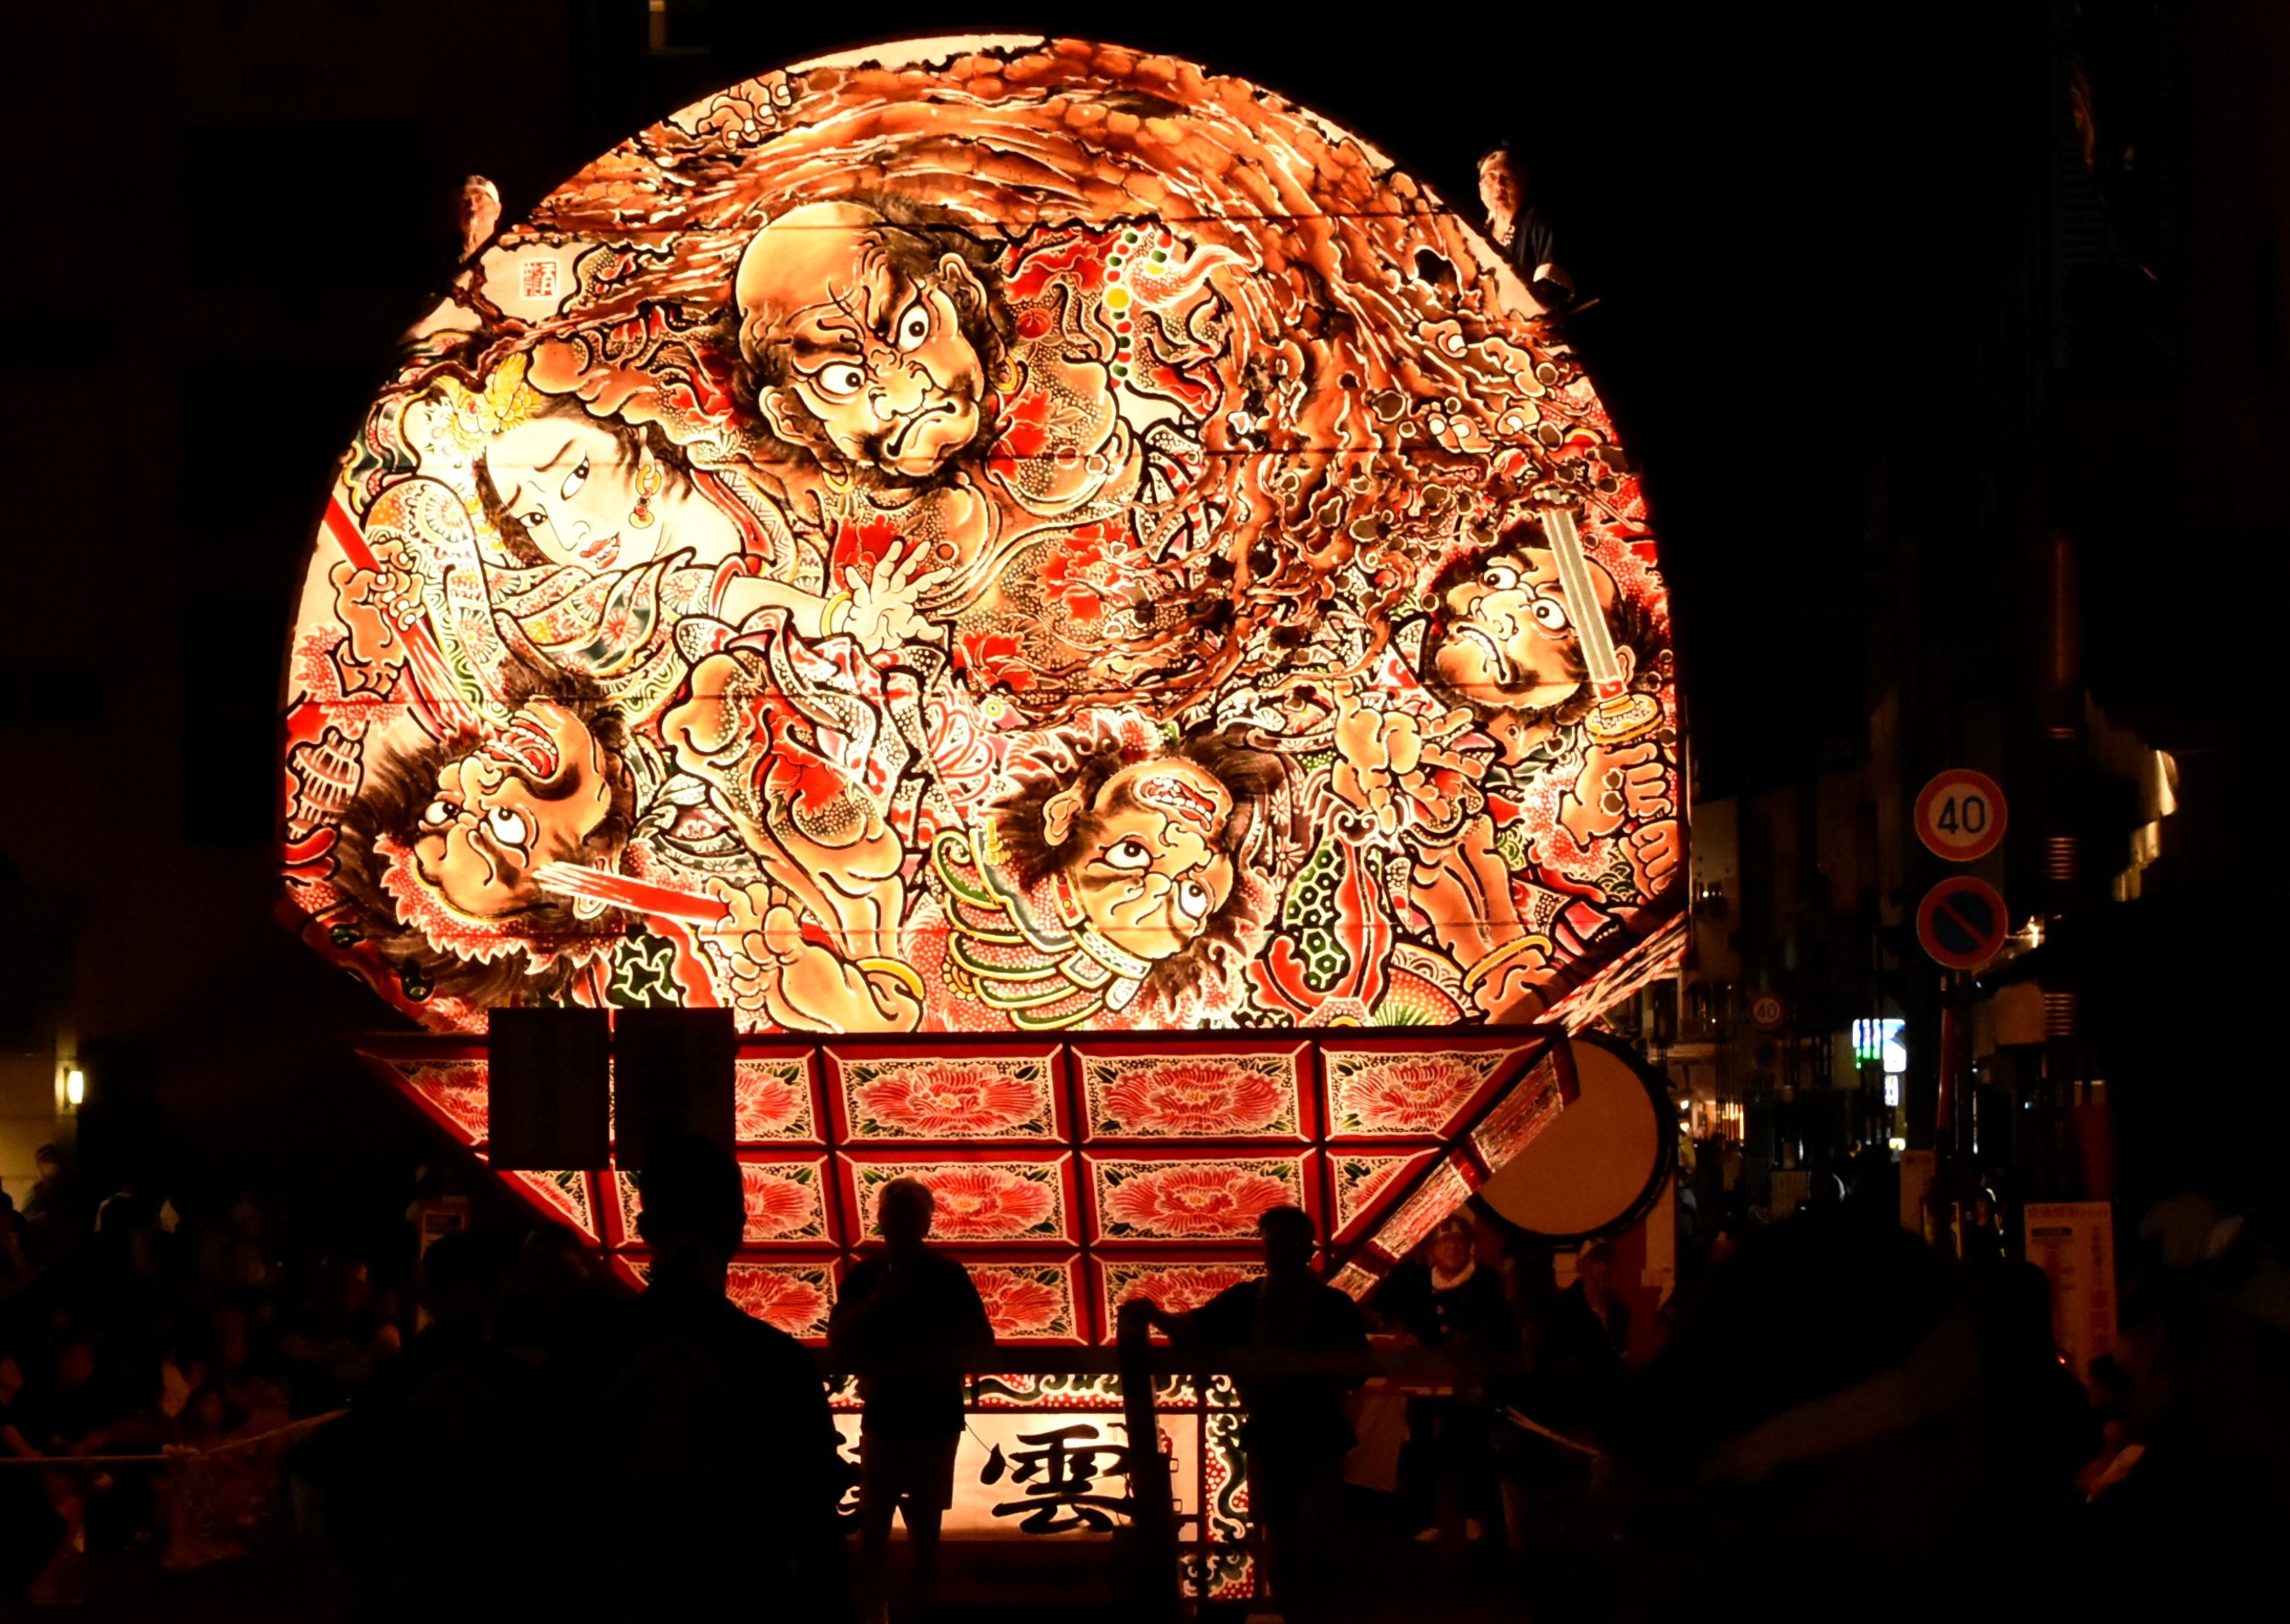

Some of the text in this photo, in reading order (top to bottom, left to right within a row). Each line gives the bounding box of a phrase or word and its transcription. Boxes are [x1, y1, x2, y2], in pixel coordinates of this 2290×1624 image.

[1938, 795, 1985, 834] 40
[1757, 1002, 1778, 1019] 40
[979, 1423, 1136, 1534] 雲
